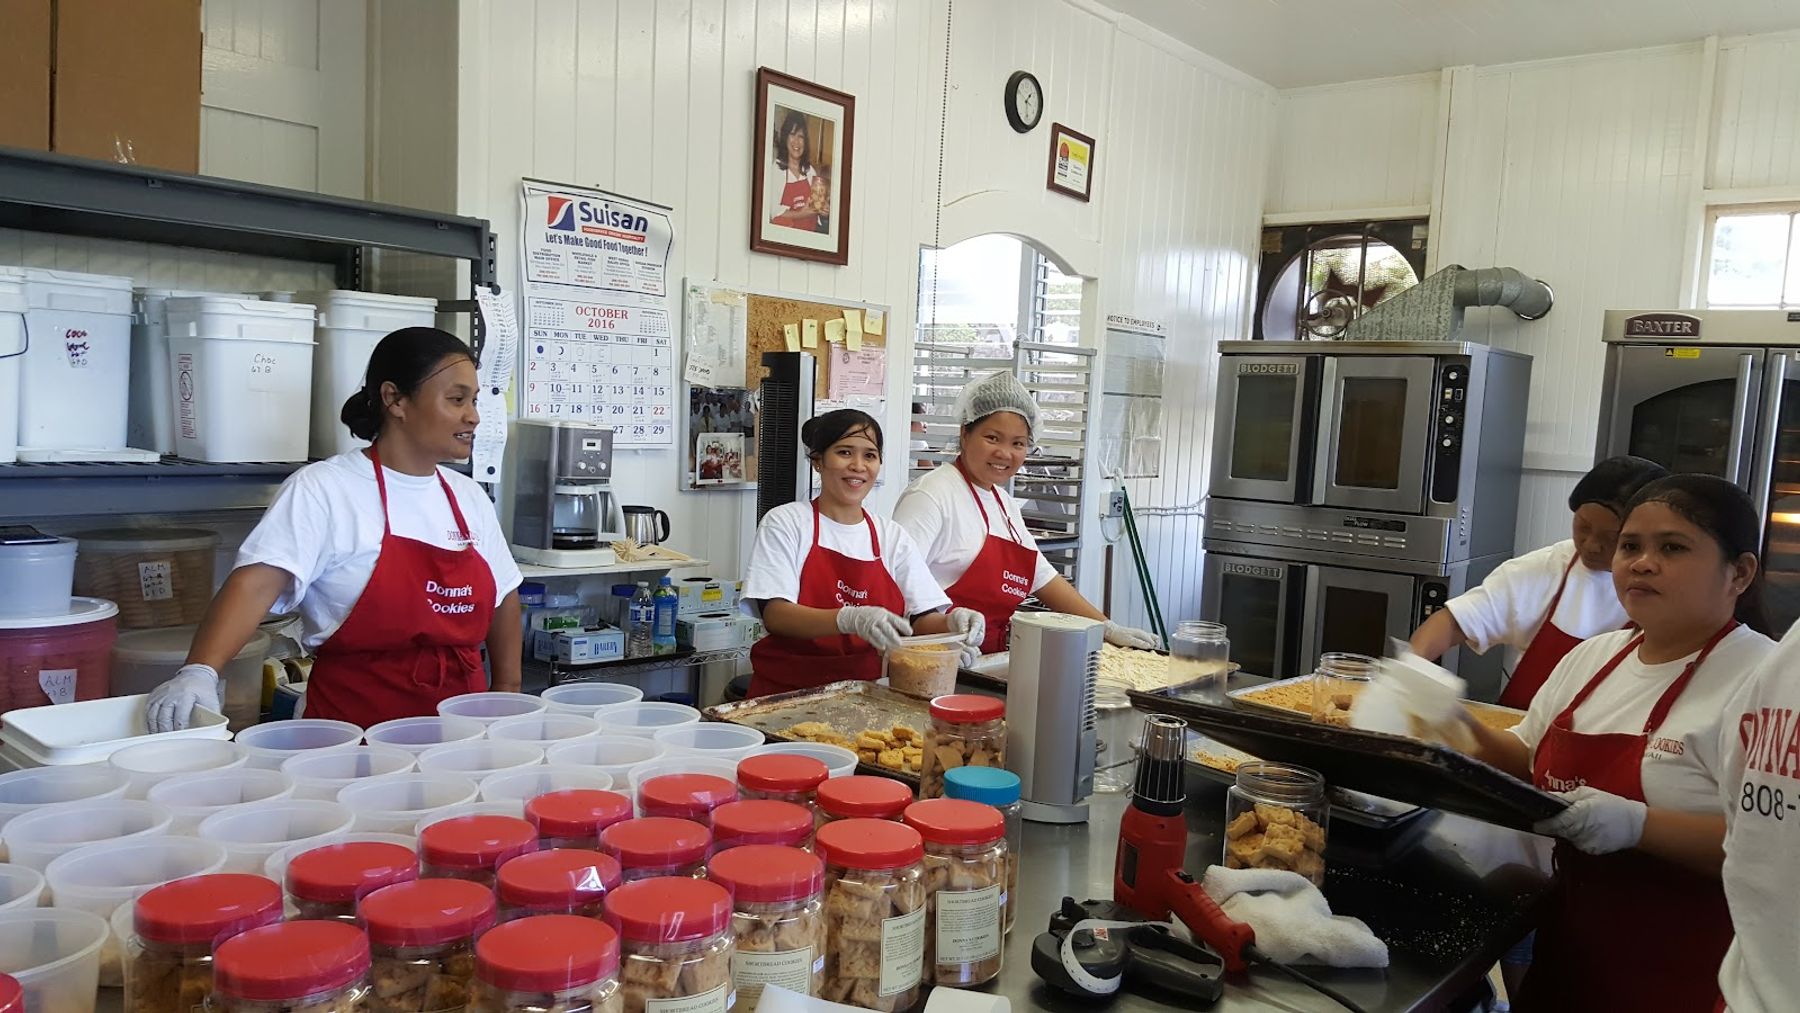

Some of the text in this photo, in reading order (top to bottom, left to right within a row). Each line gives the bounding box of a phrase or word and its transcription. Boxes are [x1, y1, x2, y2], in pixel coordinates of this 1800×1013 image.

[579, 202, 648, 232] Suisan
[545, 233, 562, 245] Let's
[564, 235, 584, 247] Make
[585, 237, 602, 249] Good
[603, 239, 618, 251] Food
[619, 242, 644, 256] Together
[576, 306, 628, 319] OCTOBER
[1107, 315, 1123, 323] NOTICE
[588, 319, 615, 329] 2016
[1633, 319, 1692, 334] BAXTER
[654, 348, 658, 357] 1
[531, 361, 659, 376] 2 3 4 5 6 7 8
[1240, 364, 1296, 373] BLODGETT
[530, 382, 664, 396] 9 10 11 12 13 14 15
[530, 404, 664, 415] 16 17 18 19 20 21 22
[613, 425, 664, 435] 27 28 29
[1225, 563, 1279, 577] BLODGETT
[1003, 570, 1028, 586] Donna's
[426, 580, 473, 598] Donna's
[45, 675, 72, 686] ALM
[1650, 737, 1685, 756] OOKIES
[1741, 781, 1800, 821] 808-
